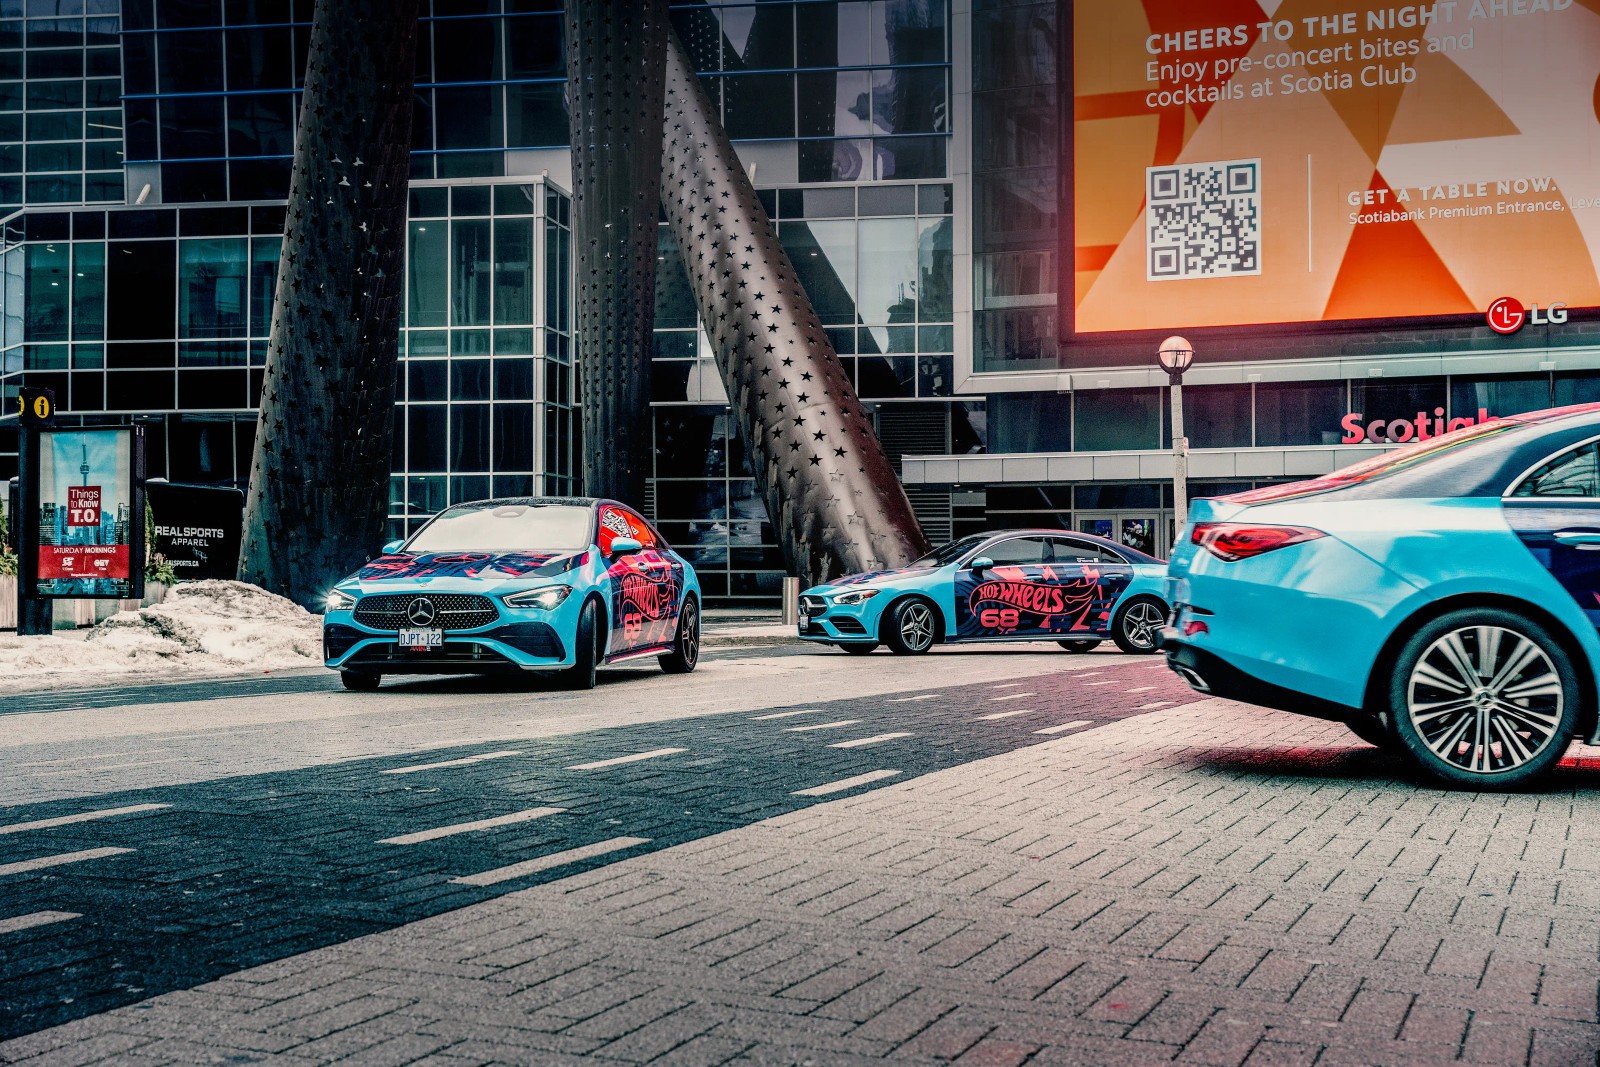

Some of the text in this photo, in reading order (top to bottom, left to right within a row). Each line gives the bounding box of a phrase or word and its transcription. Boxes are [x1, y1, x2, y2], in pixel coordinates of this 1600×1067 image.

[1145, 0, 1573, 54] CHEERS TO THE NIGHT AHEAD
[1146, 27, 1474, 84] Enjoy pre-concert bites and
[1145, 62, 1417, 108] cocktails at Scotia Club
[1347, 176, 1558, 206] GET A TABLE NOW.
[1349, 209, 1425, 225] Scotiabank
[1429, 203, 1493, 219] Premium
[1497, 197, 1565, 215] Entrance,
[1531, 302, 1568, 325] LG
[70, 489, 99, 500] Things
[70, 499, 99, 508] to Know
[70, 508, 99, 523] T.O.
[84, 546, 116, 554] MORNINGS
[171, 538, 209, 547] APPAREL
[979, 583, 999, 601] HOT
[623, 612, 642, 641] 68
[980, 608, 1019, 628] 68
[400, 633, 441, 645] DJPT 122
